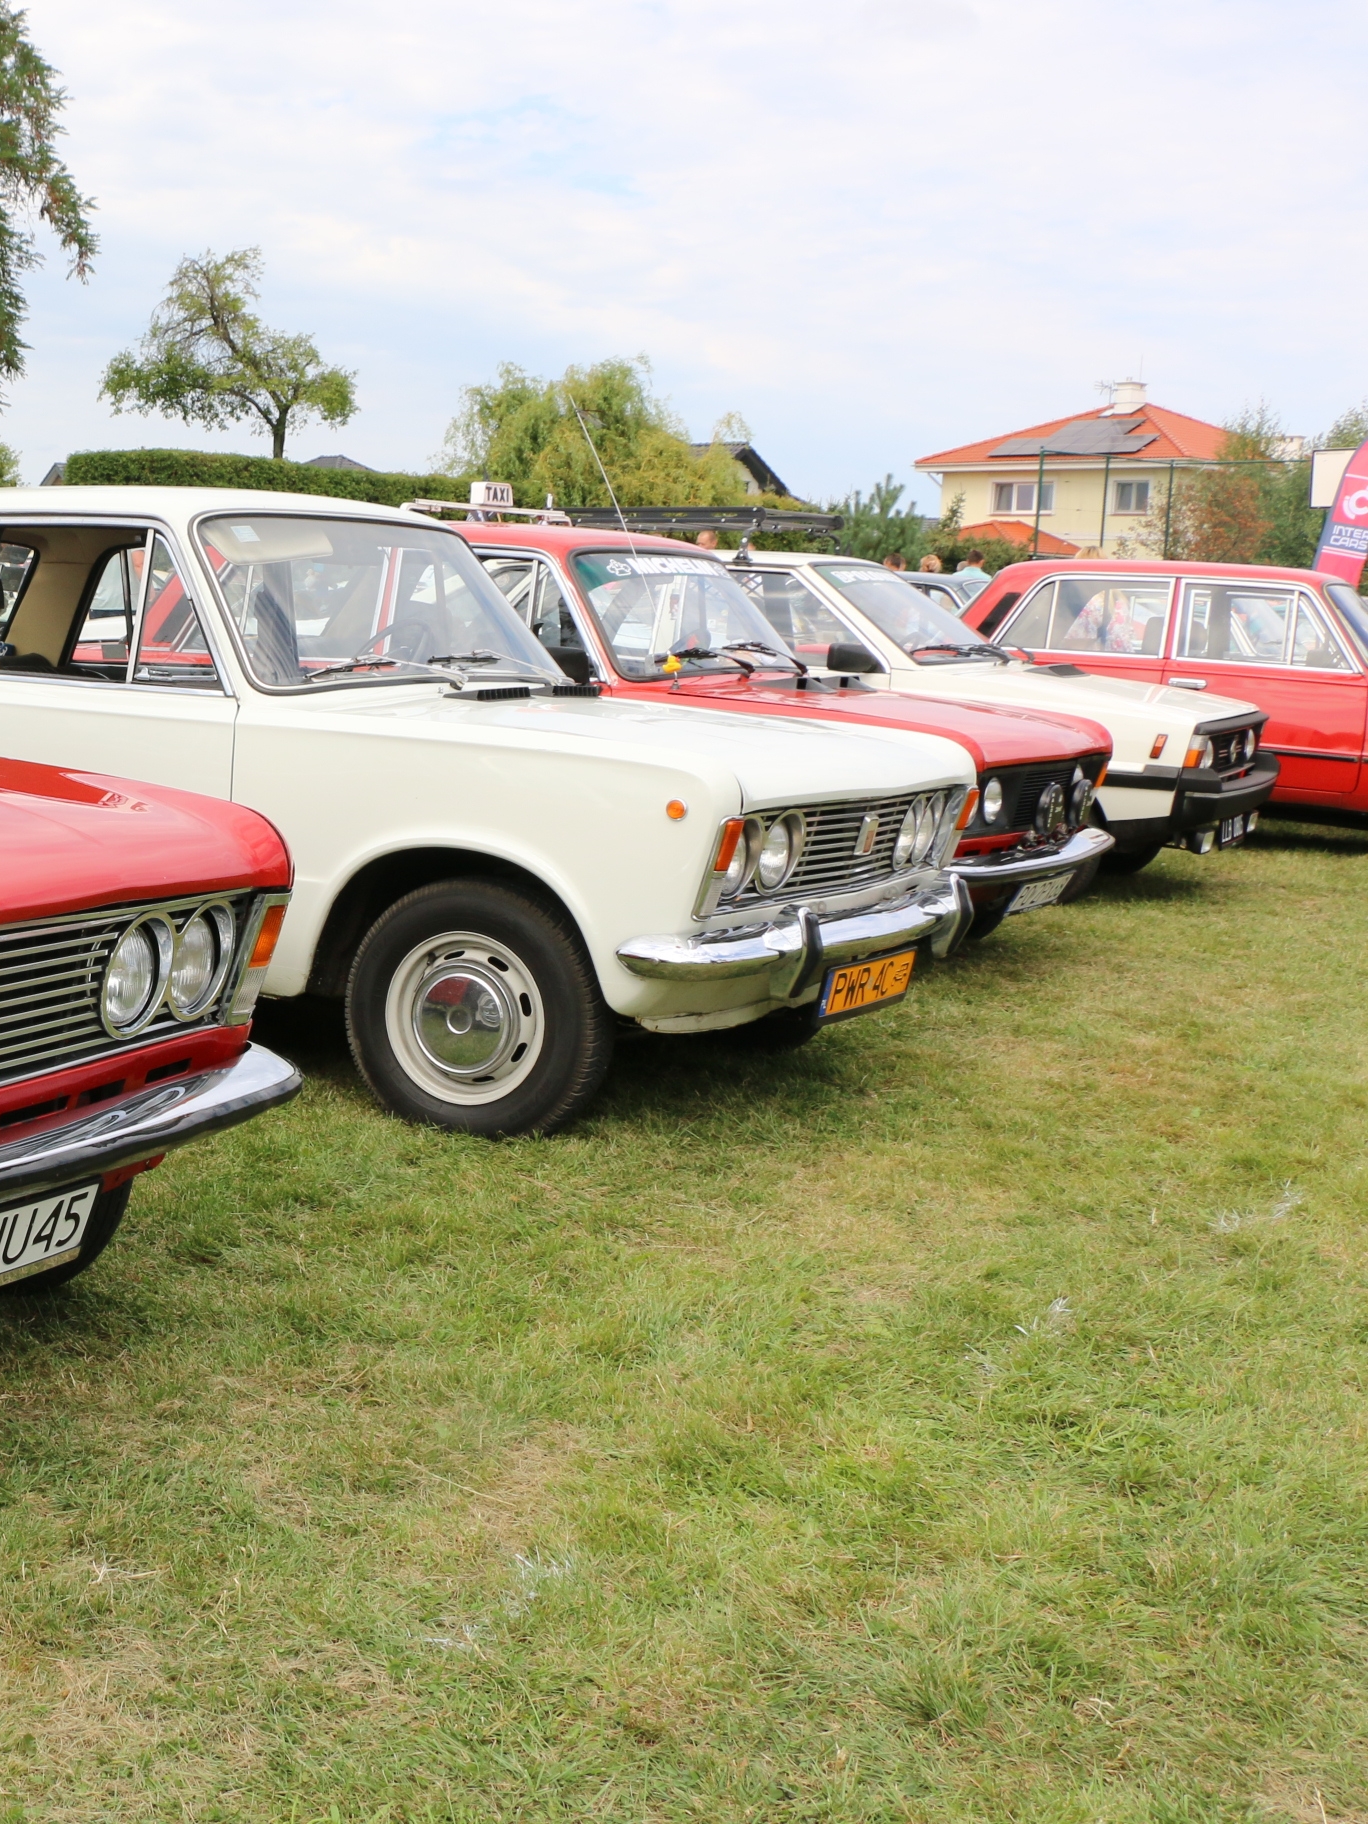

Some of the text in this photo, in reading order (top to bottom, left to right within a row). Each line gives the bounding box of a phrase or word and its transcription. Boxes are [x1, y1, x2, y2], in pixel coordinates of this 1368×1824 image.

[486, 486, 510, 503] TAXI
[1333, 525, 1368, 540] INTER
[1330, 536, 1368, 550] CARS
[625, 557, 720, 577] MICHELIN
[829, 966, 871, 1012] PWR
